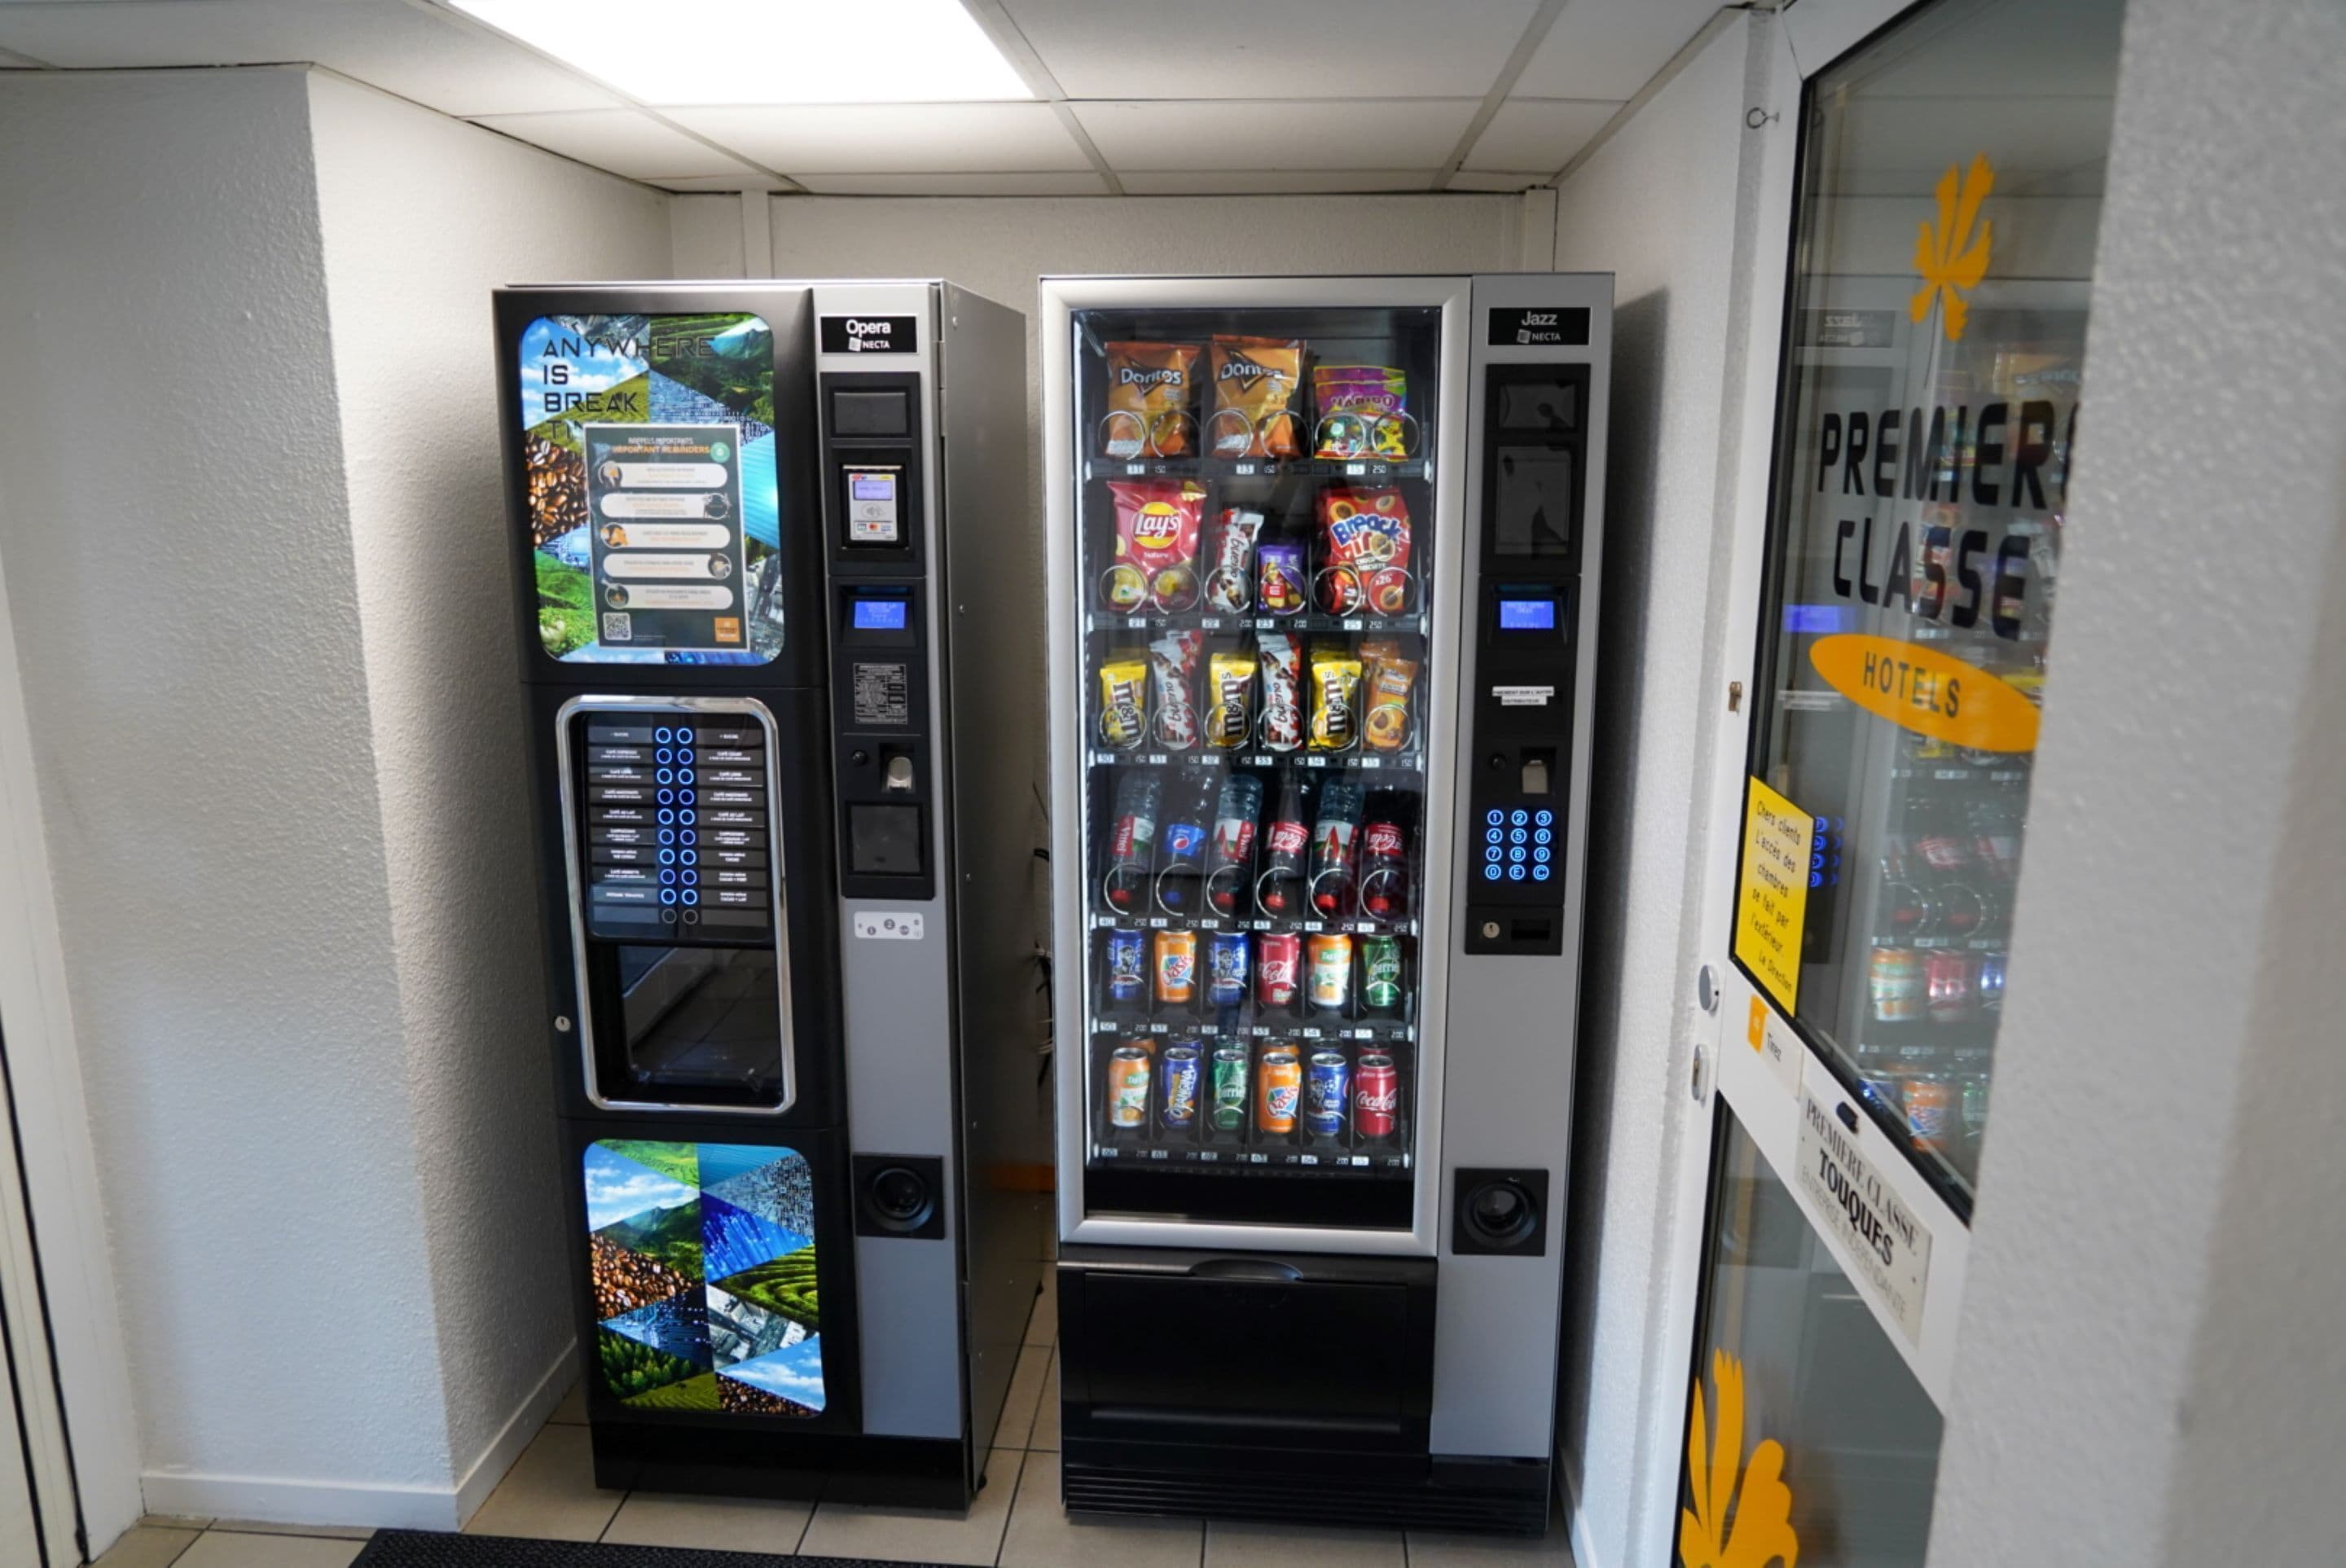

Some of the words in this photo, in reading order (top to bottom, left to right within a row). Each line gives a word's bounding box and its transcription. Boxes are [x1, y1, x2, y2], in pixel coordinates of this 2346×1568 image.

[846, 318, 891, 338] Opera
[1521, 310, 1557, 326] Jazz
[543, 336, 715, 358] ANYWHERE
[862, 340, 890, 349] NECTA
[1531, 332, 1561, 341] NECTA
[543, 364, 569, 385] IS
[1121, 367, 1182, 384] Doritos
[544, 392, 639, 413] BREAK
[1817, 399, 2080, 510] PREMIER
[1834, 517, 2030, 641] CLASSE
[1864, 651, 1961, 718] HOTELS
[1757, 800, 1775, 826] Chers
[1778, 819, 1800, 845] clients
[1783, 854, 1795, 873] des
[1757, 863, 1789, 898] chambres
[1752, 888, 1760, 903] se
[1777, 911, 1790, 929] par
[1820, 1147, 1894, 1267] TOUQUES
[1867, 1175, 1918, 1256] CLASSE
